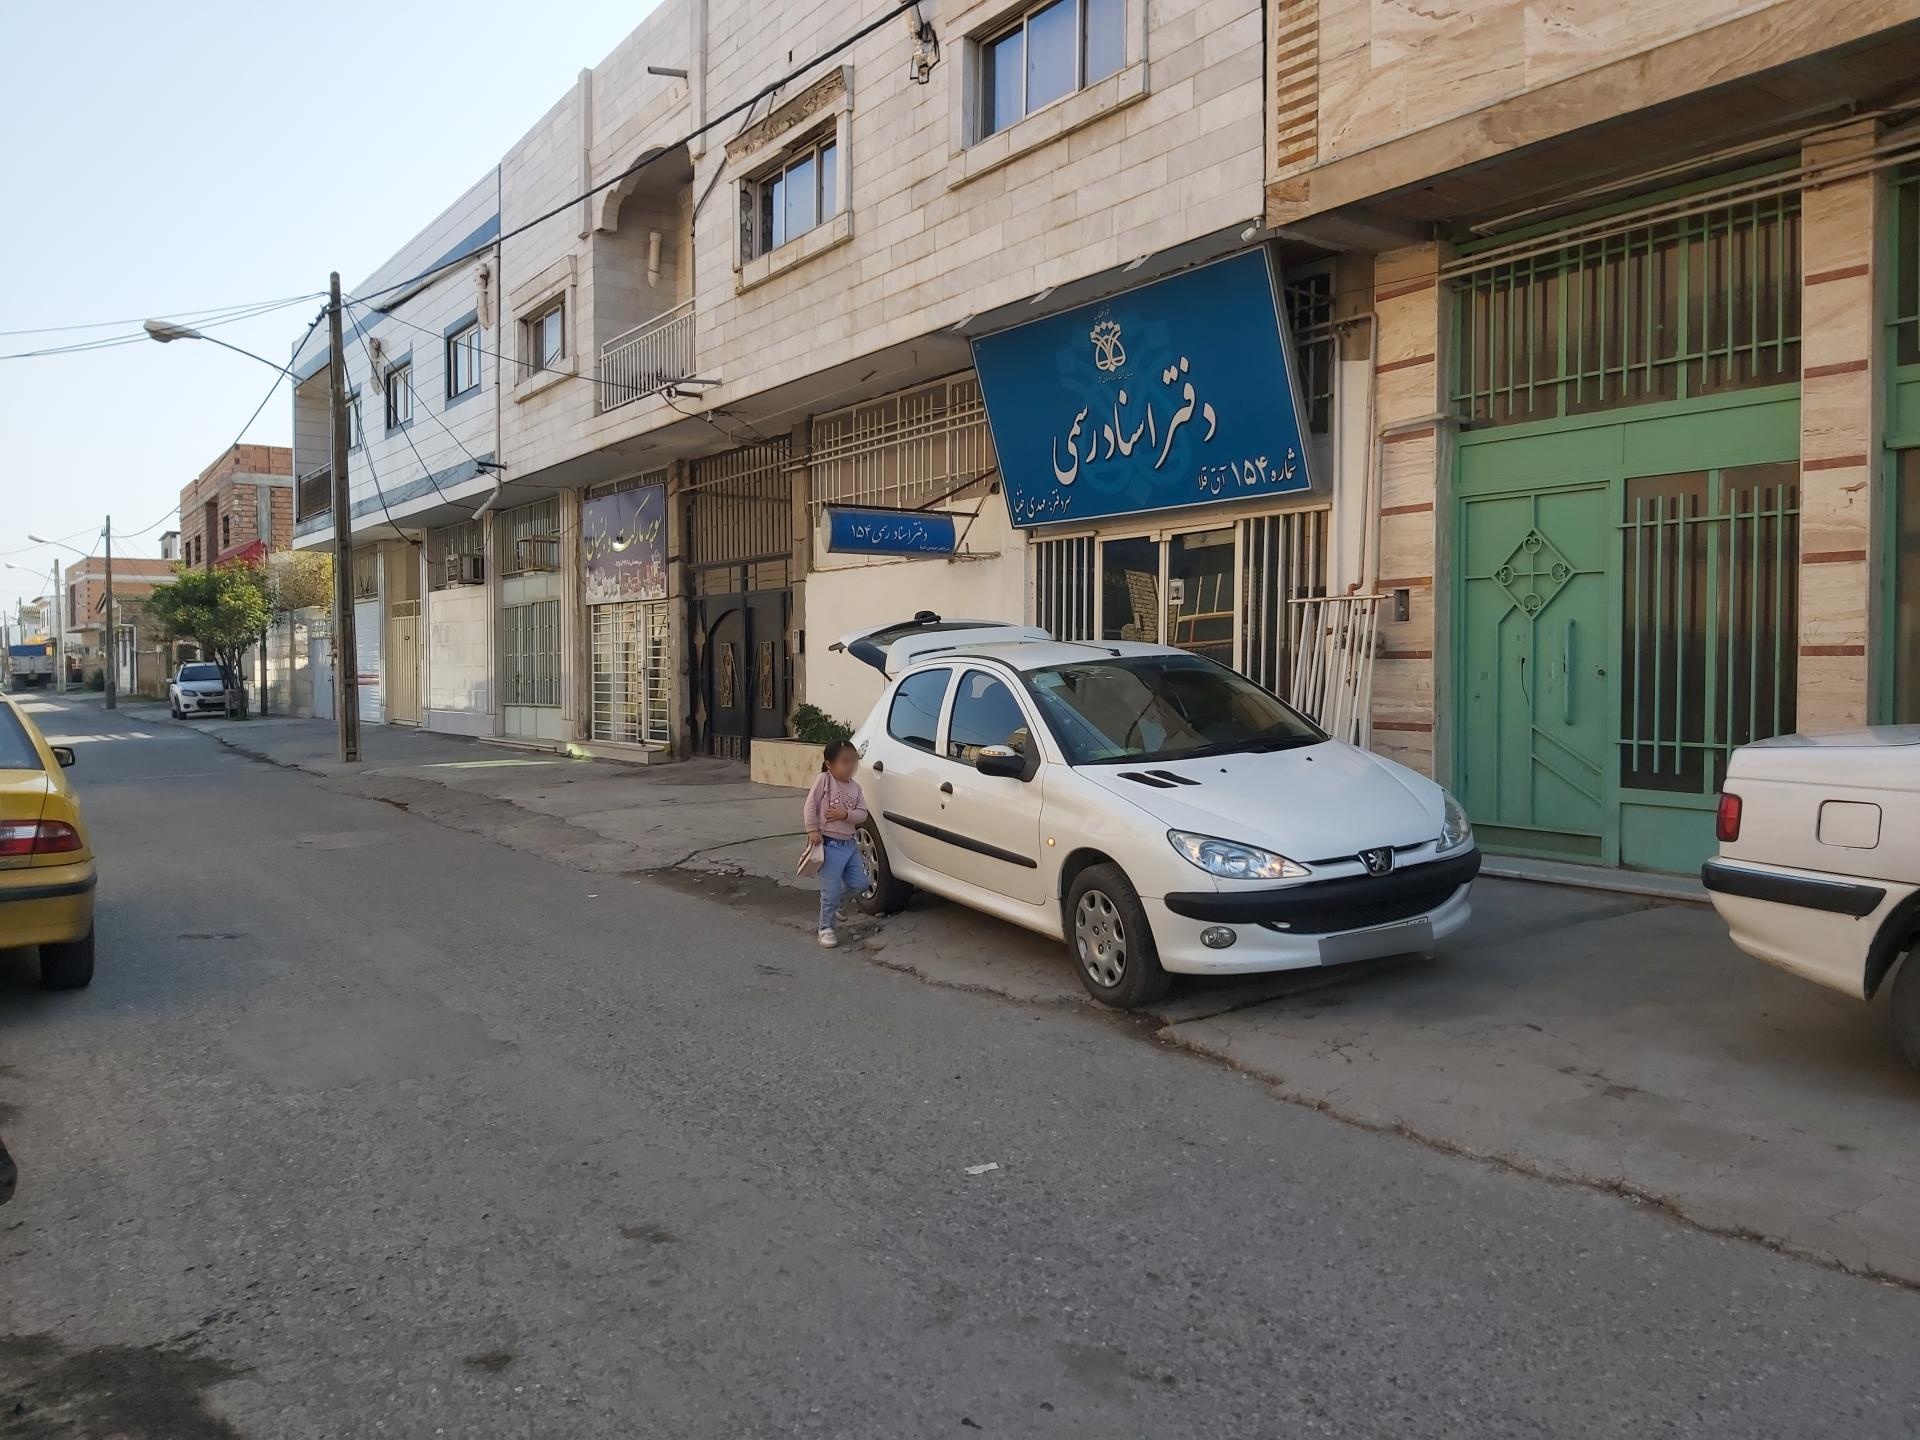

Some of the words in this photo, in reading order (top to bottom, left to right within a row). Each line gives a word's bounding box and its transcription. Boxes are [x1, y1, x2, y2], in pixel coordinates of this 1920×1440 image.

[1104, 389, 1156, 460] اسناد
[1155, 356, 1217, 470] دفتر
[1053, 404, 1097, 486] رسمی
[1230, 456, 1268, 487] ۱۵۴
[1271, 447, 1297, 482] شماره
[1026, 496, 1046, 518] مهدی
[850, 524, 872, 538] ۱۵۴
[871, 525, 891, 544] رسمی
[893, 525, 911, 541] اسناد
[908, 520, 928, 544] دفتر
